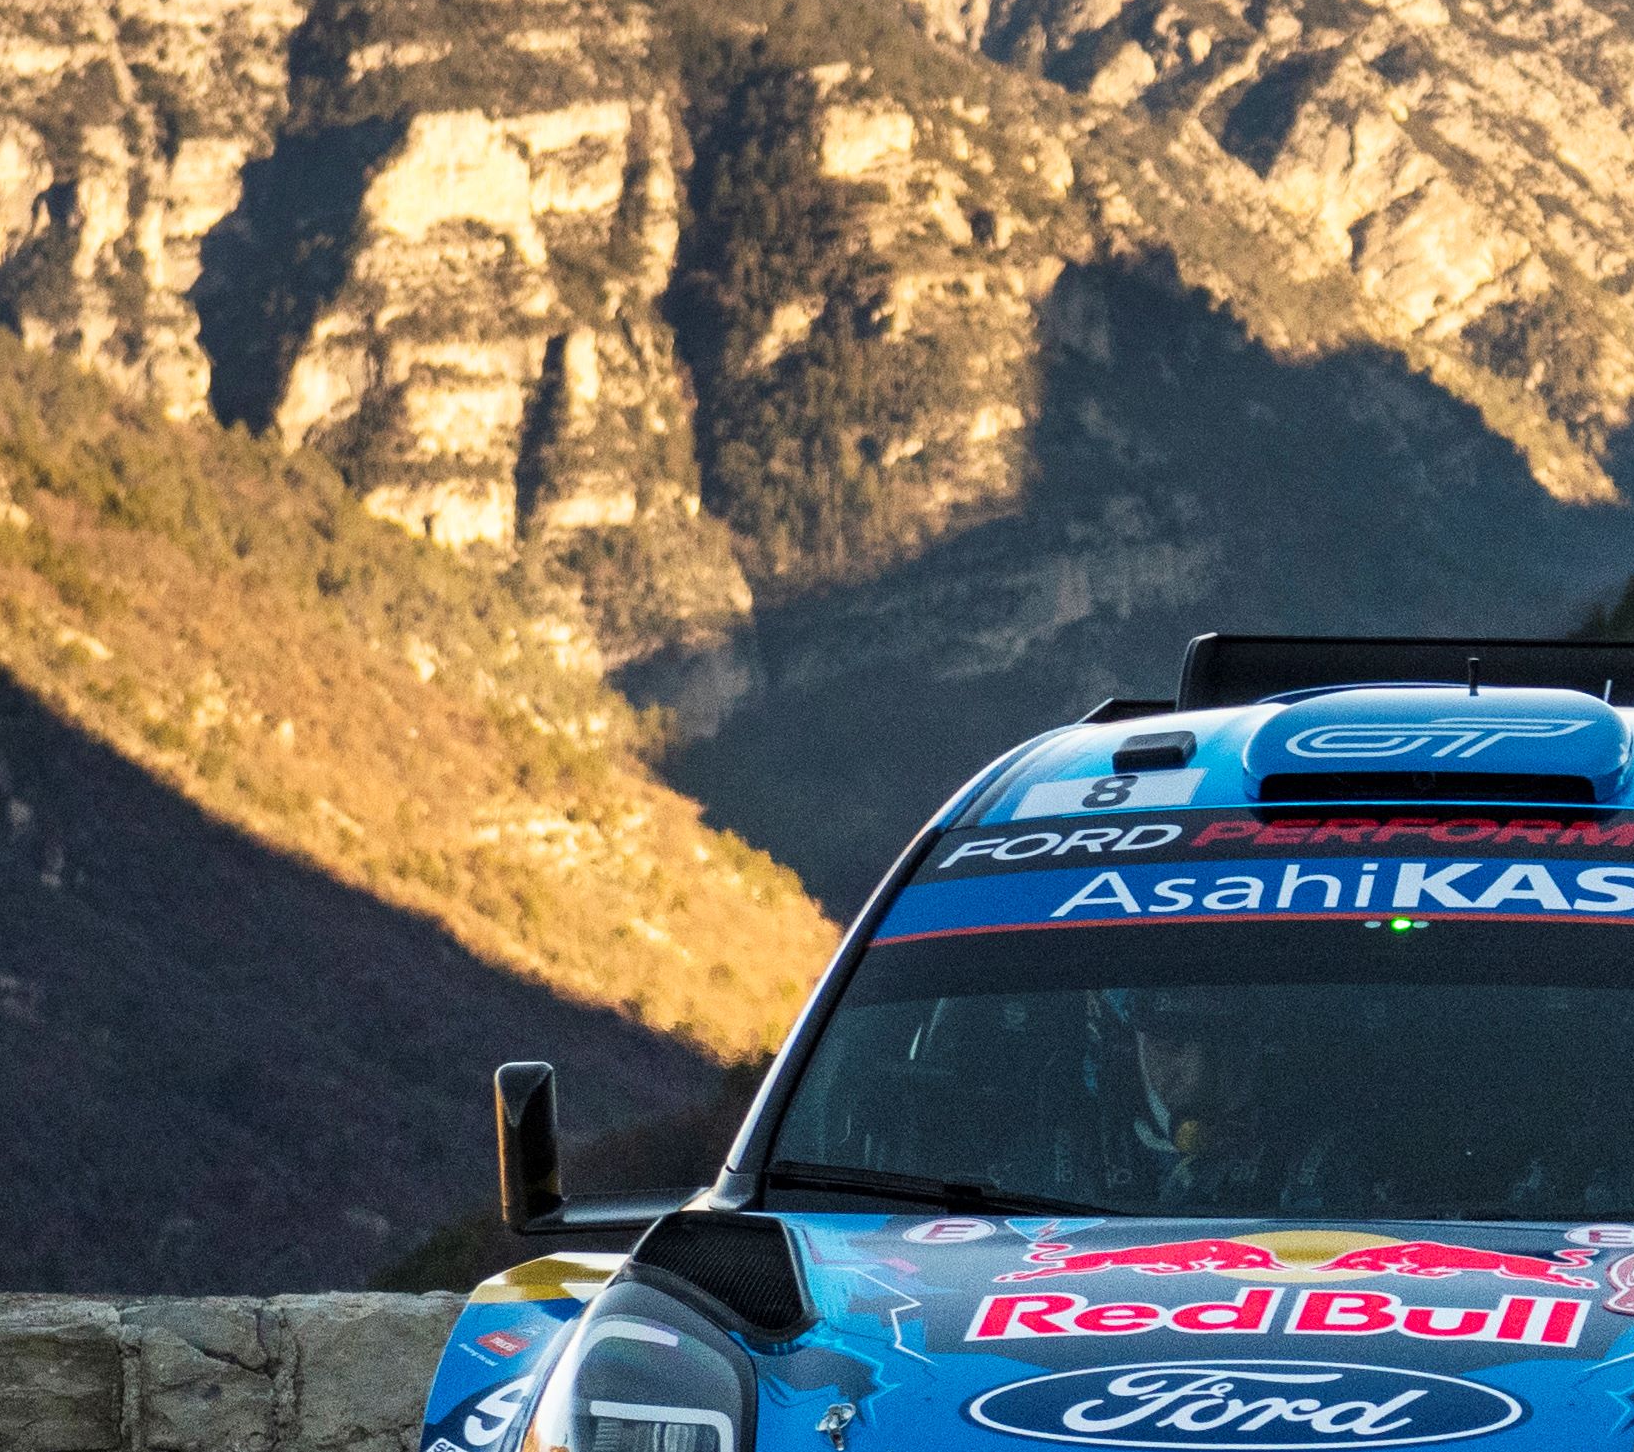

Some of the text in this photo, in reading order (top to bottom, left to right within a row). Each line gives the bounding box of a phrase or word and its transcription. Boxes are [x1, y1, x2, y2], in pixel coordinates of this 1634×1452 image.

[1081, 776, 1138, 808] 8
[938, 824, 1184, 869] FORD
[965, 1287, 1592, 1348] Red Bull
[1063, 1369, 1428, 1436] Ford
